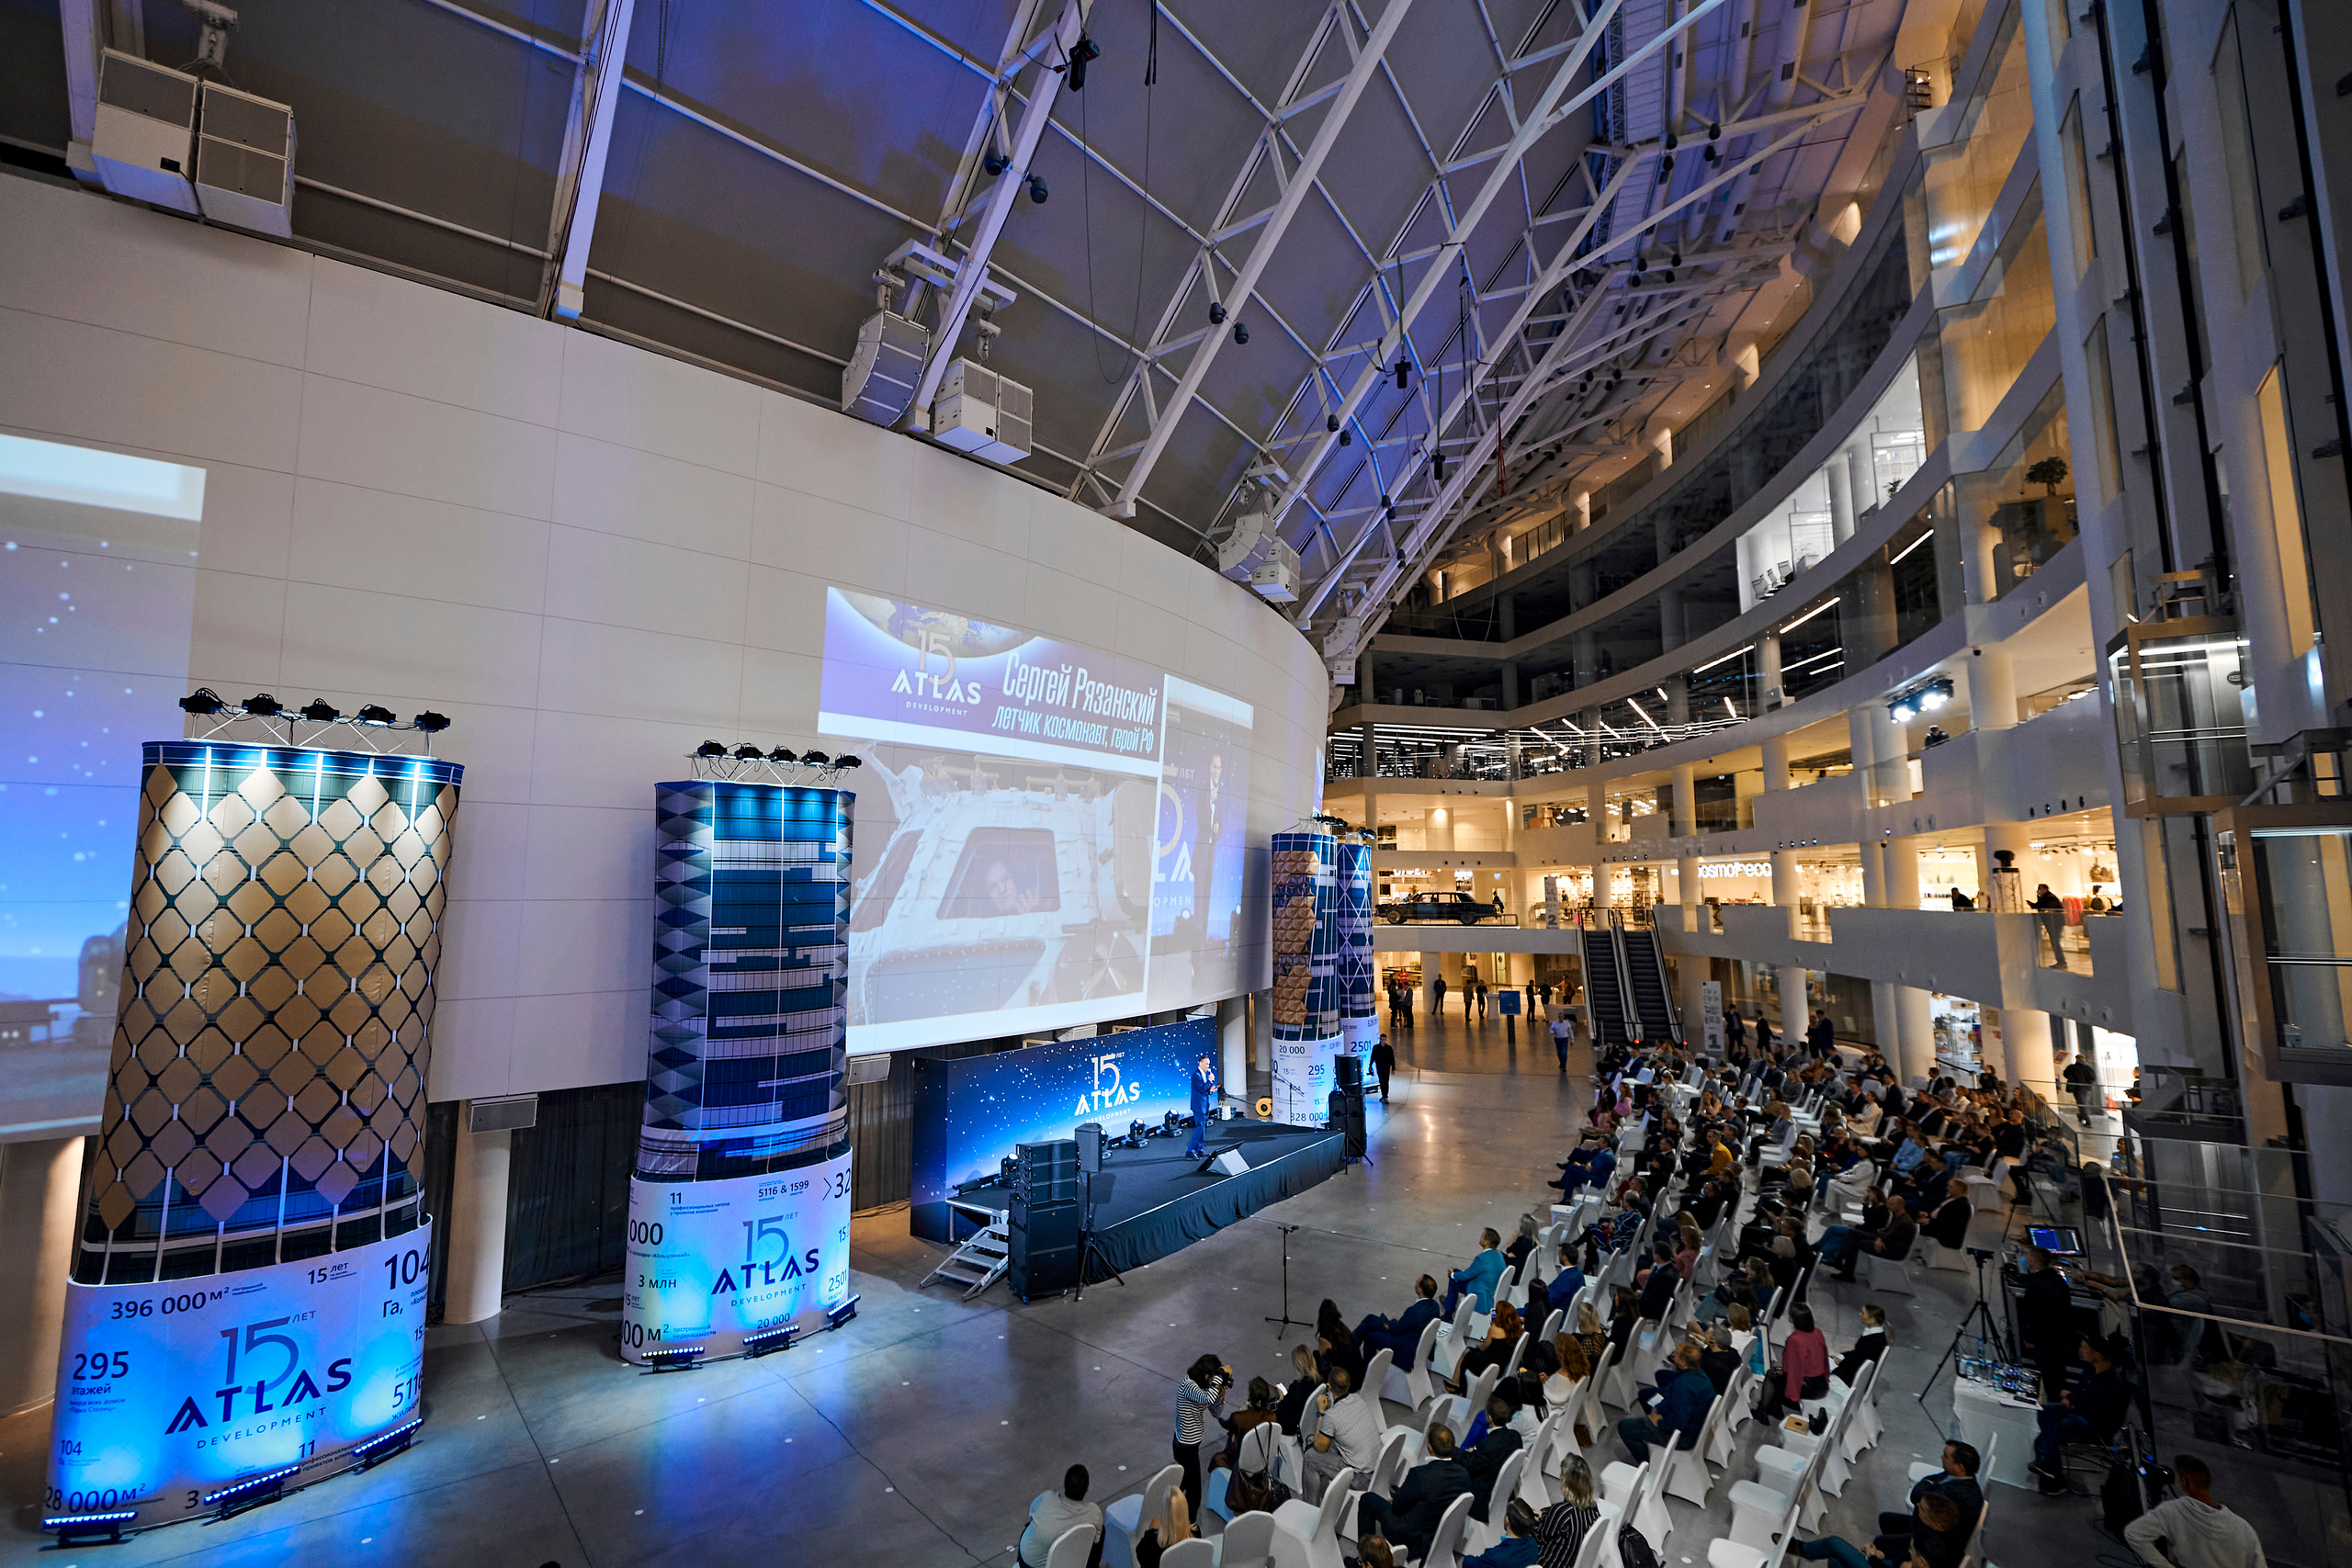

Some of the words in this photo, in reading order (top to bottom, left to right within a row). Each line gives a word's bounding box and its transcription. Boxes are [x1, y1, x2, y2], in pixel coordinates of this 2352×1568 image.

[918, 628, 955, 685] 15
[890, 669, 981, 705] ATLAS
[1002, 650, 1073, 706] Сергей
[1071, 667, 1158, 726] Рязанский
[906, 701, 968, 716] DEVELOPMENT
[991, 705, 1043, 735] летчик
[1043, 714, 1109, 749] космонавт,
[1110, 728, 1139, 752] герой
[1139, 727, 1155, 754] РФ
[1279, 1045, 1287, 1054] 20
[1351, 1040, 1372, 1053] 2501
[1708, 1033, 1722, 1050] 1
[1091, 1054, 1121, 1098] 15
[1308, 1064, 1326, 1076] 295
[1074, 1081, 1140, 1117] ATLAS
[1086, 1108, 1131, 1124] DEVELOPMENT
[670, 1192, 683, 1204] 11
[758, 1187, 778, 1198] 5116
[780, 1184, 787, 1194] &
[790, 1179, 809, 1192] 1599
[784, 1212, 799, 1221] ЛЕТ
[629, 1219, 663, 1246] 000
[742, 1214, 789, 1271] 15
[839, 1225, 847, 1243] 15
[308, 1268, 328, 1284] 15
[330, 1262, 349, 1273] лет
[384, 1242, 431, 1291] 104
[711, 1248, 820, 1295] ATLAS
[639, 1274, 645, 1288] 3
[649, 1279, 677, 1289] млн
[828, 1269, 847, 1293] 2501
[625, 1292, 631, 1306] 15
[730, 1282, 807, 1307] DEVELOPMENT
[111, 1299, 153, 1320] 396
[161, 1292, 207, 1314] 000
[382, 1300, 403, 1318] Га,
[292, 1310, 317, 1324] ЛЕТ
[757, 1317, 770, 1329] 20
[773, 1313, 790, 1326] 000
[414, 1325, 424, 1341] 15
[73, 1350, 130, 1381] 295
[220, 1315, 300, 1395] 15
[71, 1382, 111, 1396] этажей
[164, 1358, 352, 1436] ATLAS
[197, 1406, 327, 1450] DEVELOPMENT
[61, 1438, 83, 1456] 104
[299, 1438, 316, 1459] 11
[302, 1457, 334, 1472] проектов
[45, 1485, 62, 1512] 28
[68, 1488, 118, 1514] 000
[185, 1489, 199, 1510] 3
